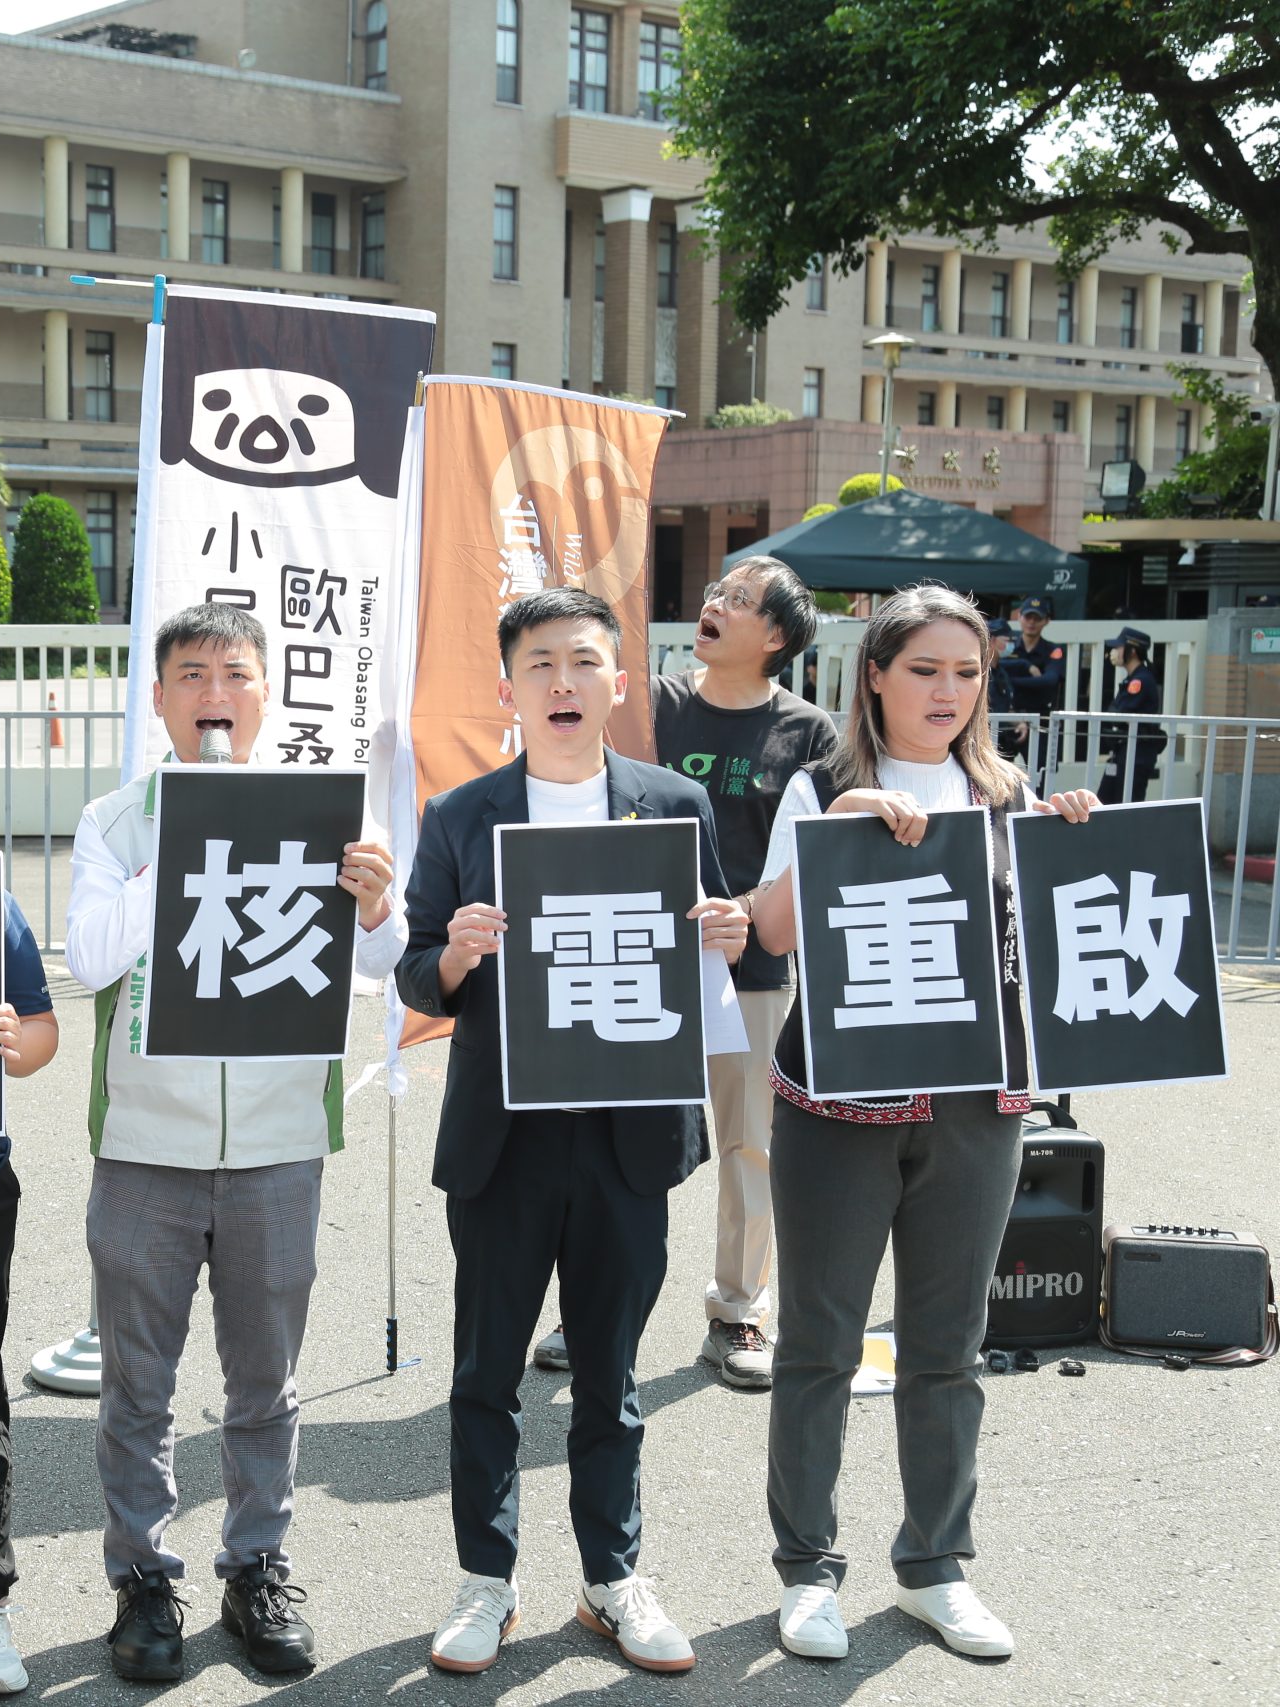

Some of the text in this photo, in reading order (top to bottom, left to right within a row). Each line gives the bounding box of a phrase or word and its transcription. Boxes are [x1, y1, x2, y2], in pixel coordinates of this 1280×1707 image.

[359, 576, 379, 638] Taiwan
[564, 534, 582, 580] Wild
[351, 646, 373, 728] Obasang
[727, 757, 751, 796] 綠黨
[177, 839, 337, 998] 核
[531, 892, 682, 1041] 電
[828, 874, 976, 1029] 重
[1052, 871, 1199, 1024] 啟
